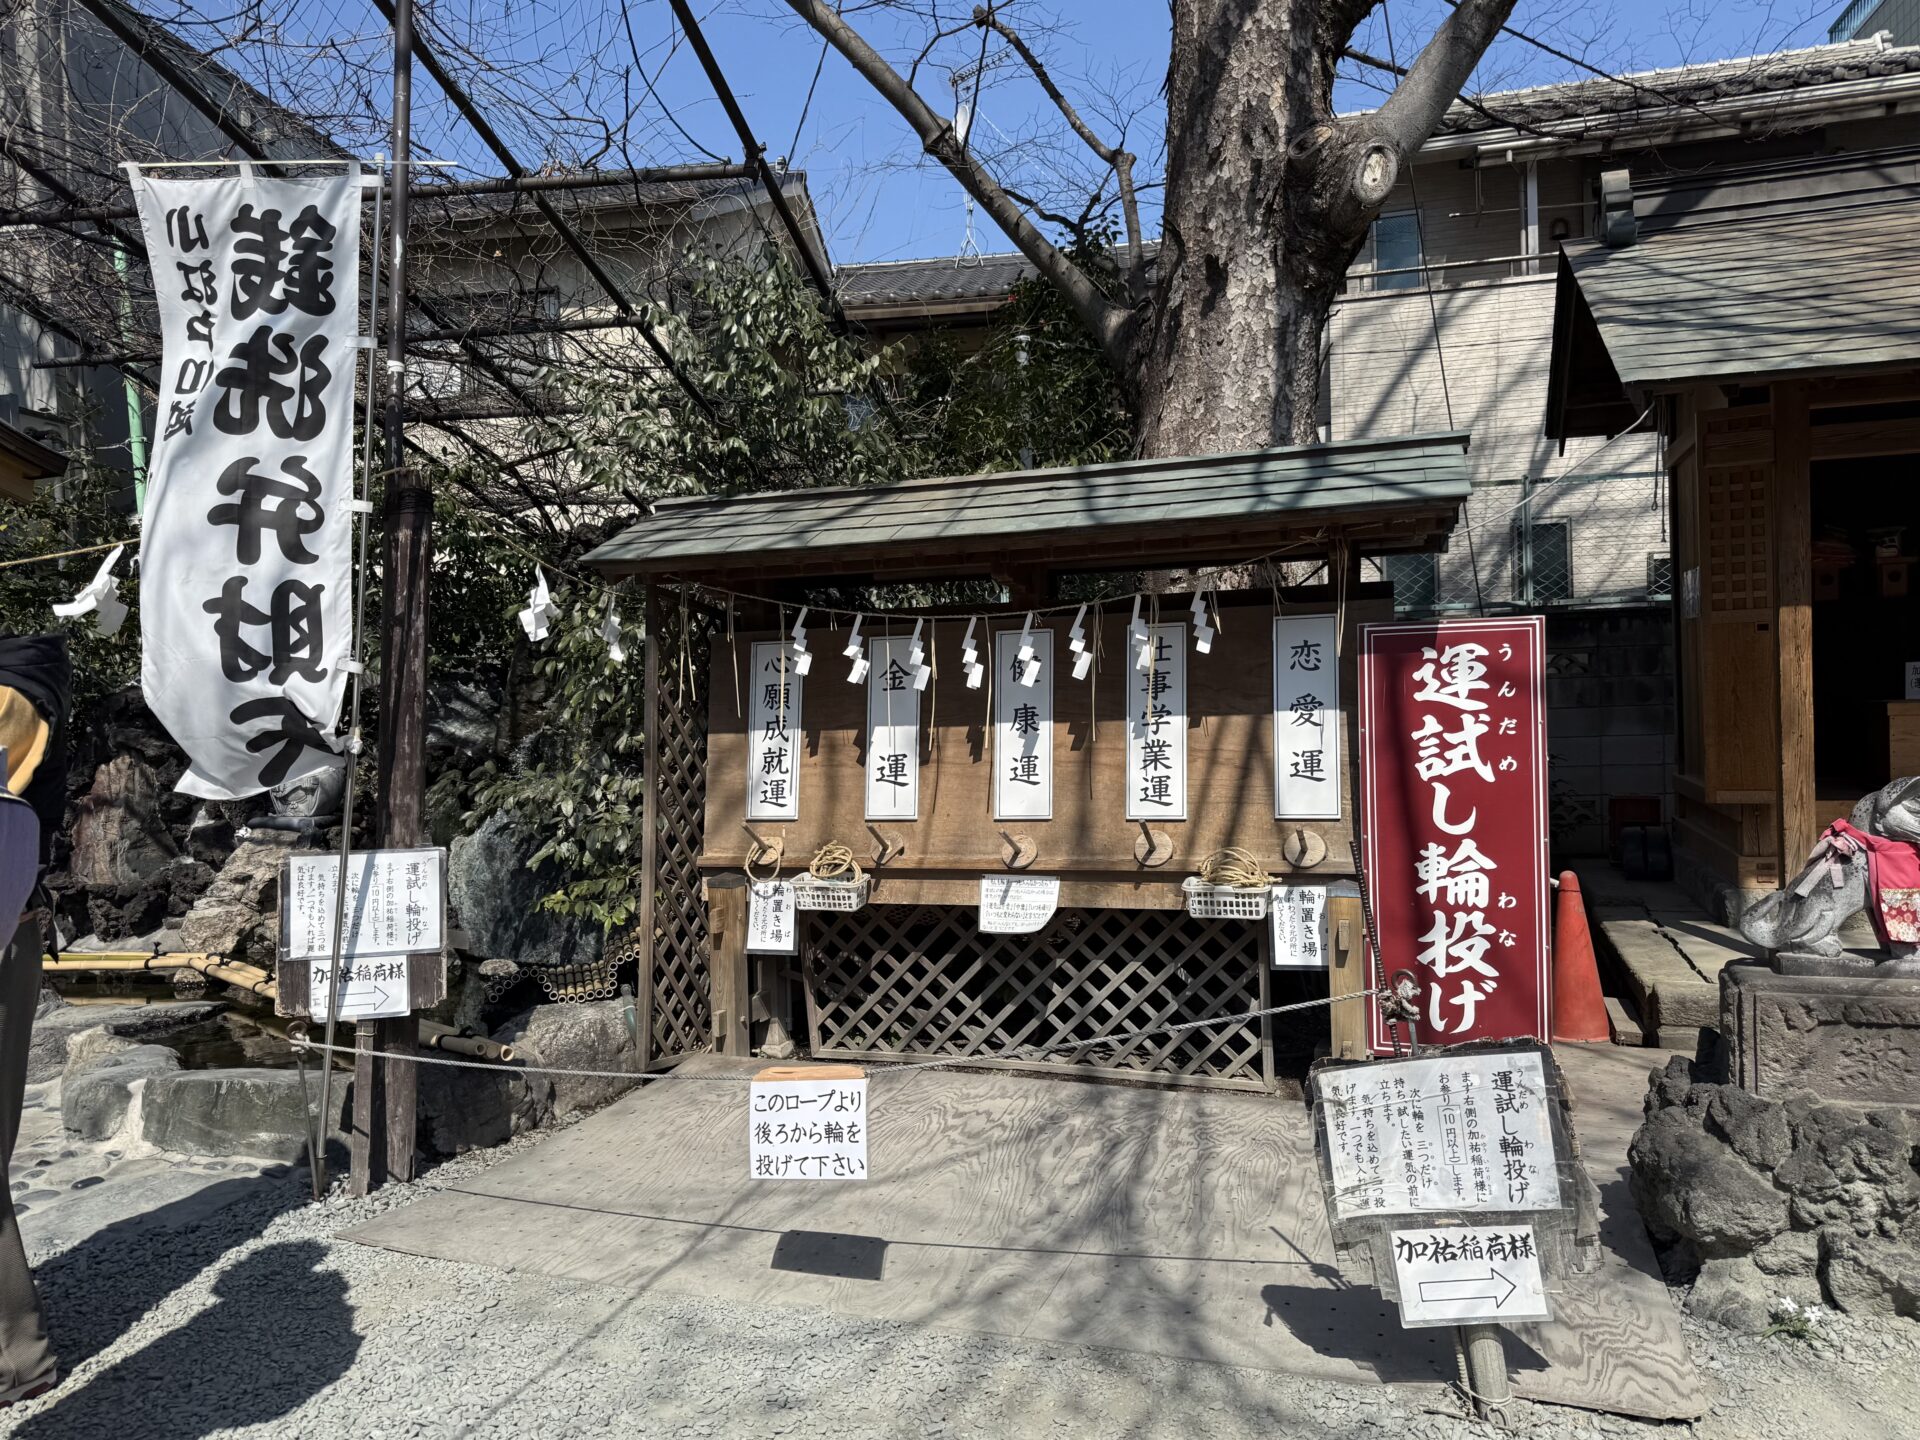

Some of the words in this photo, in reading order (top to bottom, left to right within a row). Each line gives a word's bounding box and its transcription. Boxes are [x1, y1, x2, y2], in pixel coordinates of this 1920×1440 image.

[760, 656, 792, 808] 心願成就運
[875, 658, 912, 787] 金運
[1289, 639, 1325, 784] 恋愛運
[1497, 643, 1518, 772] うんだめ
[1411, 642, 1500, 1034] 運試し輪投げ
[405, 862, 422, 946] 運試し輪投げ
[770, 884, 785, 943] 輪置き場
[1299, 889, 1317, 957] 輪置き場
[1498, 892, 1517, 948] わな
[754, 1089, 862, 1113] このロープより
[754, 1121, 861, 1145] 後ろから輪を
[1380, 1080, 1396, 1128] 立ちます。
[1461, 1071, 1487, 1203] まず右側の加祐稲荷様に
[1491, 1070, 1531, 1204] 運試し輪投げ
[755, 1152, 865, 1177] 投げて下さい
[1395, 1232, 1537, 1264] 加祐稲荷様
